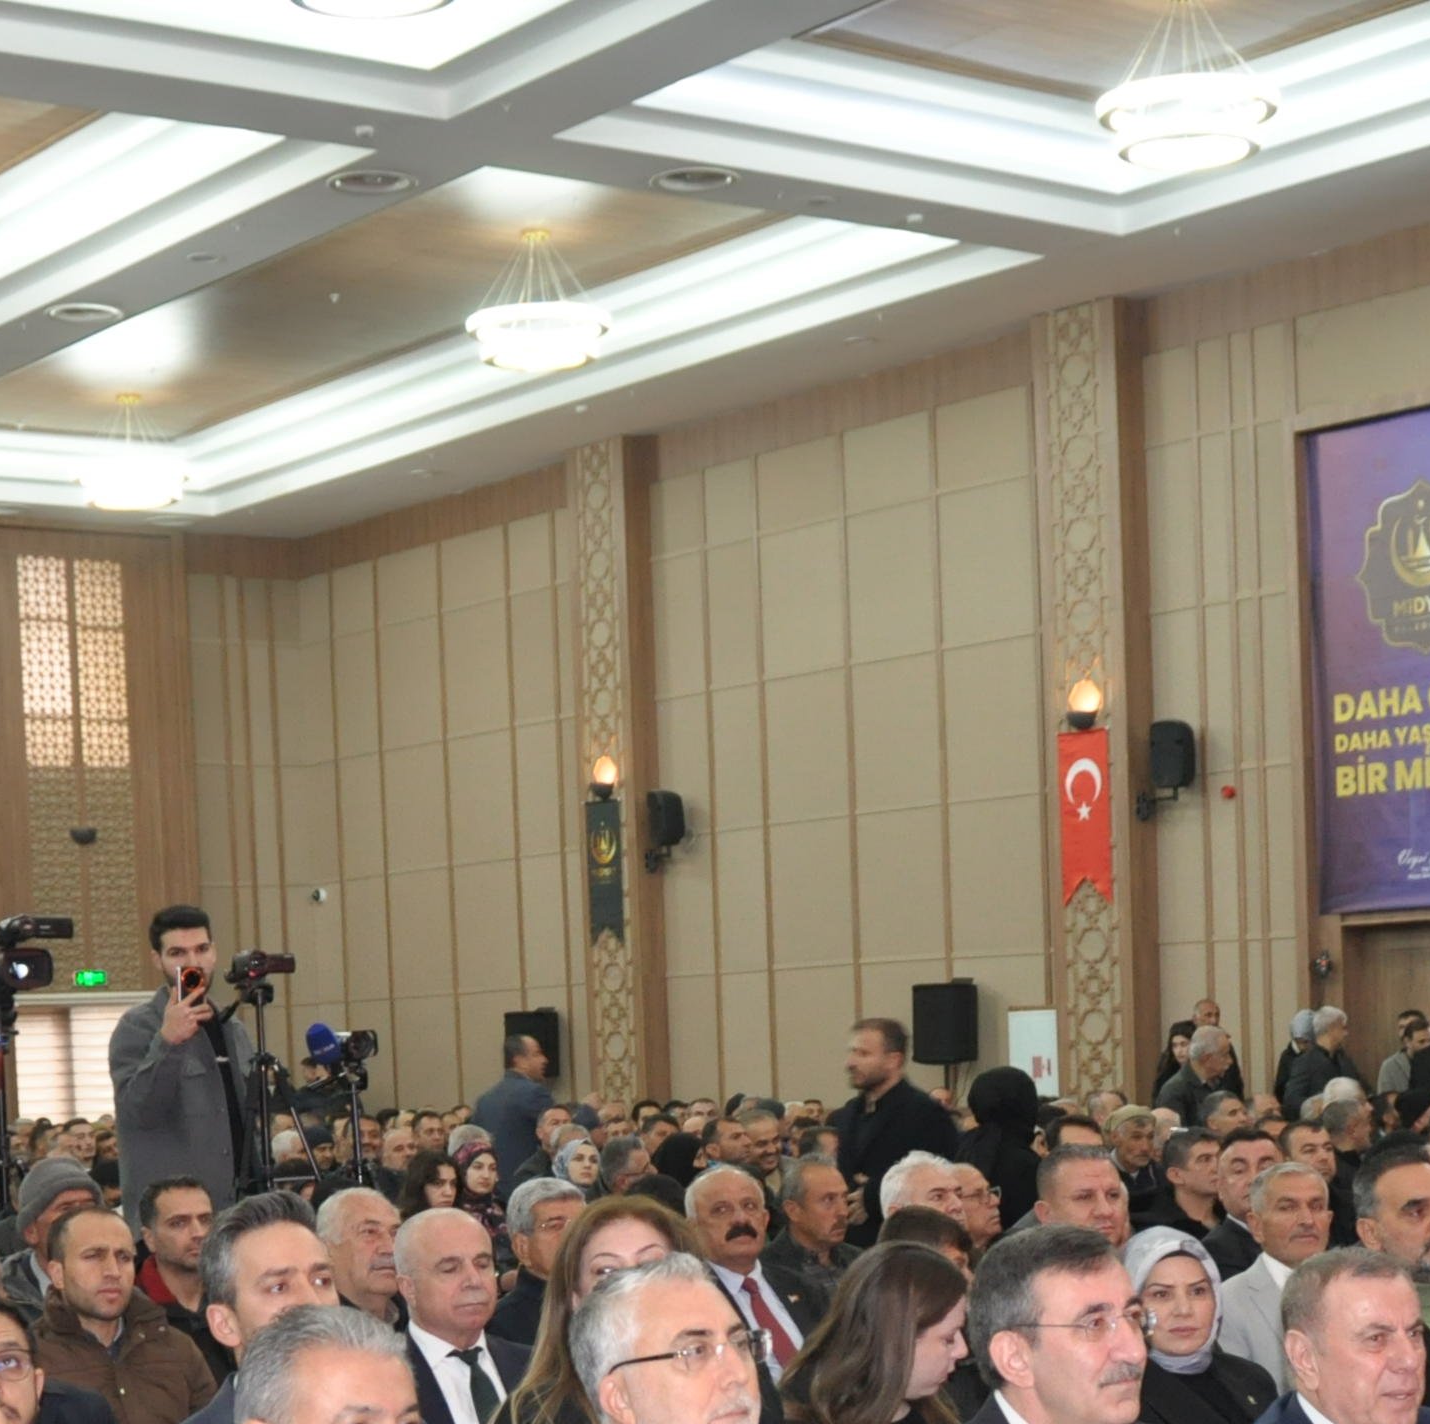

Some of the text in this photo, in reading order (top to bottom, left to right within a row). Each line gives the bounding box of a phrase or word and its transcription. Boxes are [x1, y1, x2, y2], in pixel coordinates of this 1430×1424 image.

[1333, 685, 1423, 723] DAHA
[1334, 729, 1392, 754] DAHA
[1335, 755, 1388, 797] BİR
